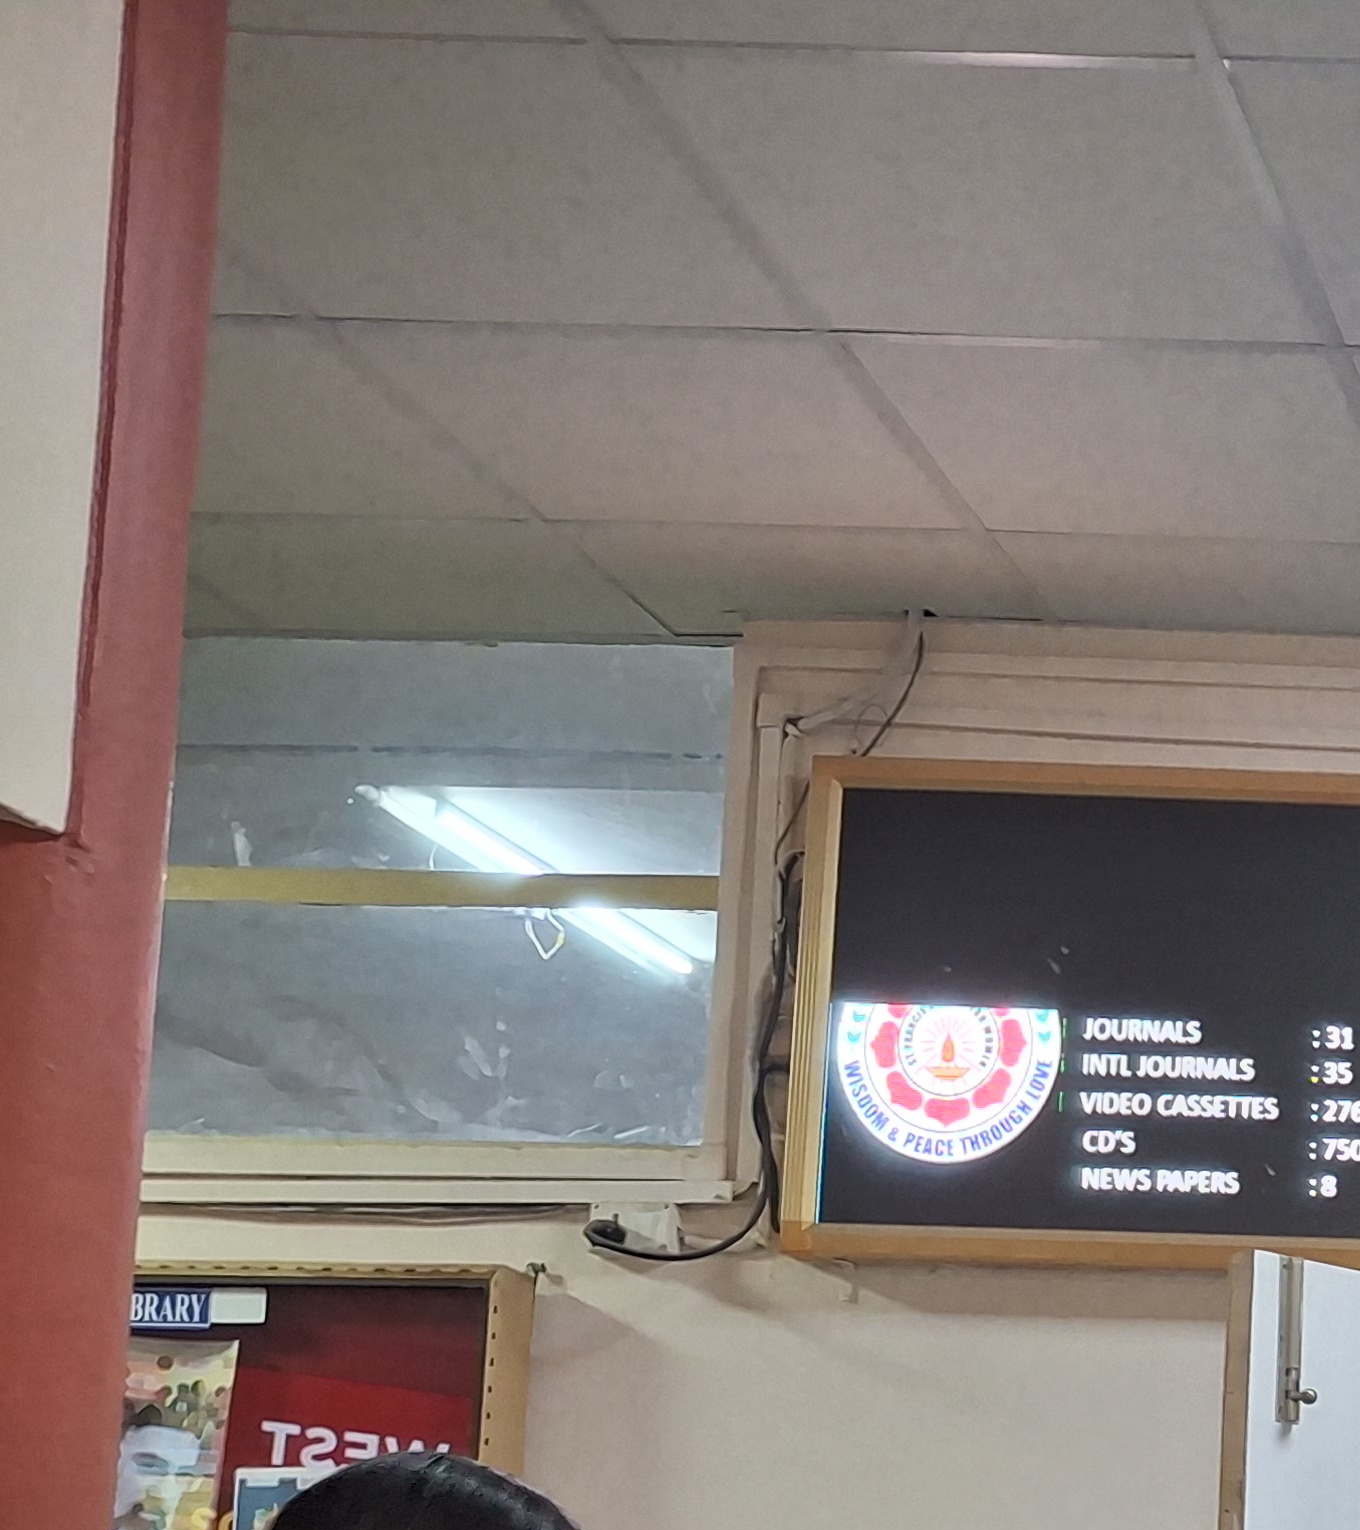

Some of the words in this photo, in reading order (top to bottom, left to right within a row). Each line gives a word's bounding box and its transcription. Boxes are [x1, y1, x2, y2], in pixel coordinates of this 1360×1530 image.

[1082, 1017, 1201, 1044] JOURNALS
[1082, 1053, 1132, 1077] INTL
[1136, 1055, 1255, 1081] JOURNALS
[844, 1059, 888, 1132] WISDOM
[887, 1127, 899, 1143] &
[903, 1131, 954, 1156] PEACE
[959, 1101, 1033, 1155] THROUGH
[1026, 1059, 1054, 1100] LOVE
[1080, 1092, 1152, 1115] VIDEO
[1156, 1093, 1280, 1120] CASSETTES
[1082, 1129, 1136, 1154] CD'S
[1080, 1167, 1152, 1192] NEWS
[1155, 1169, 1241, 1195] PAPERS
[130, 1293, 207, 1323] BRARY
